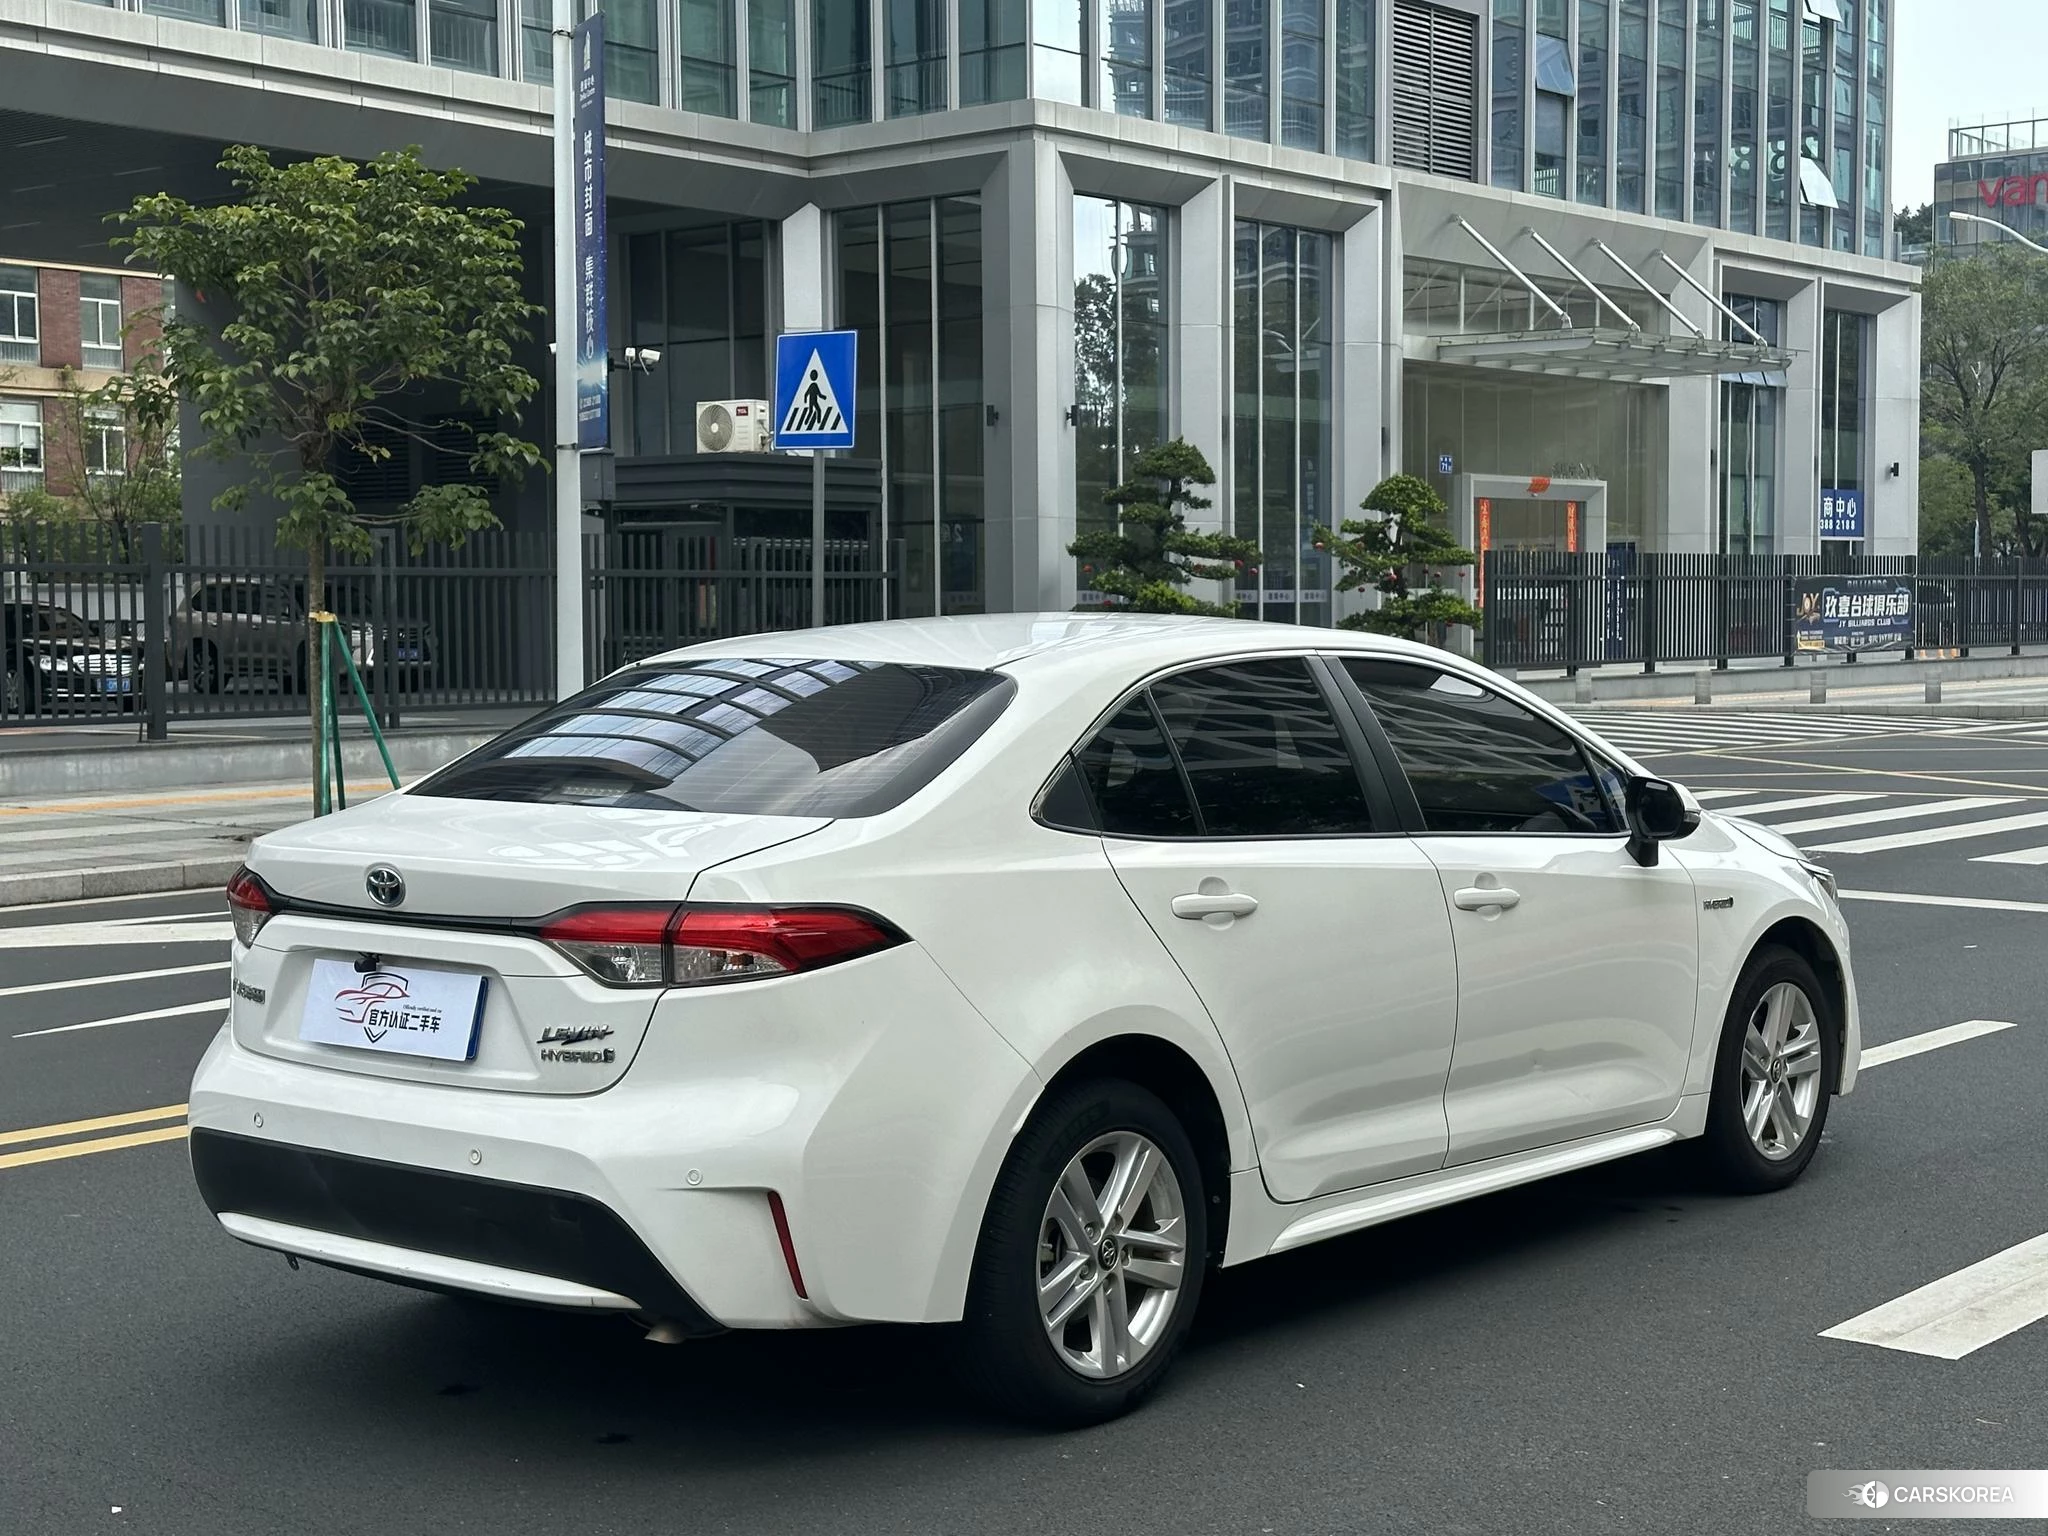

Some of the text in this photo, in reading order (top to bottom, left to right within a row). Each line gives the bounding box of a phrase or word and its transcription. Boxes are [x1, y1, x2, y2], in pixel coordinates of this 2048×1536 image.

[584, 129, 594, 359] 城市封面 集群核心
[1823, 496, 1857, 518] 商中心
[1824, 593, 1910, 618] 玖壹台球俱乐部
[1876, 618, 1891, 627] CLUB
[368, 1009, 441, 1033] 官方认证二手车
